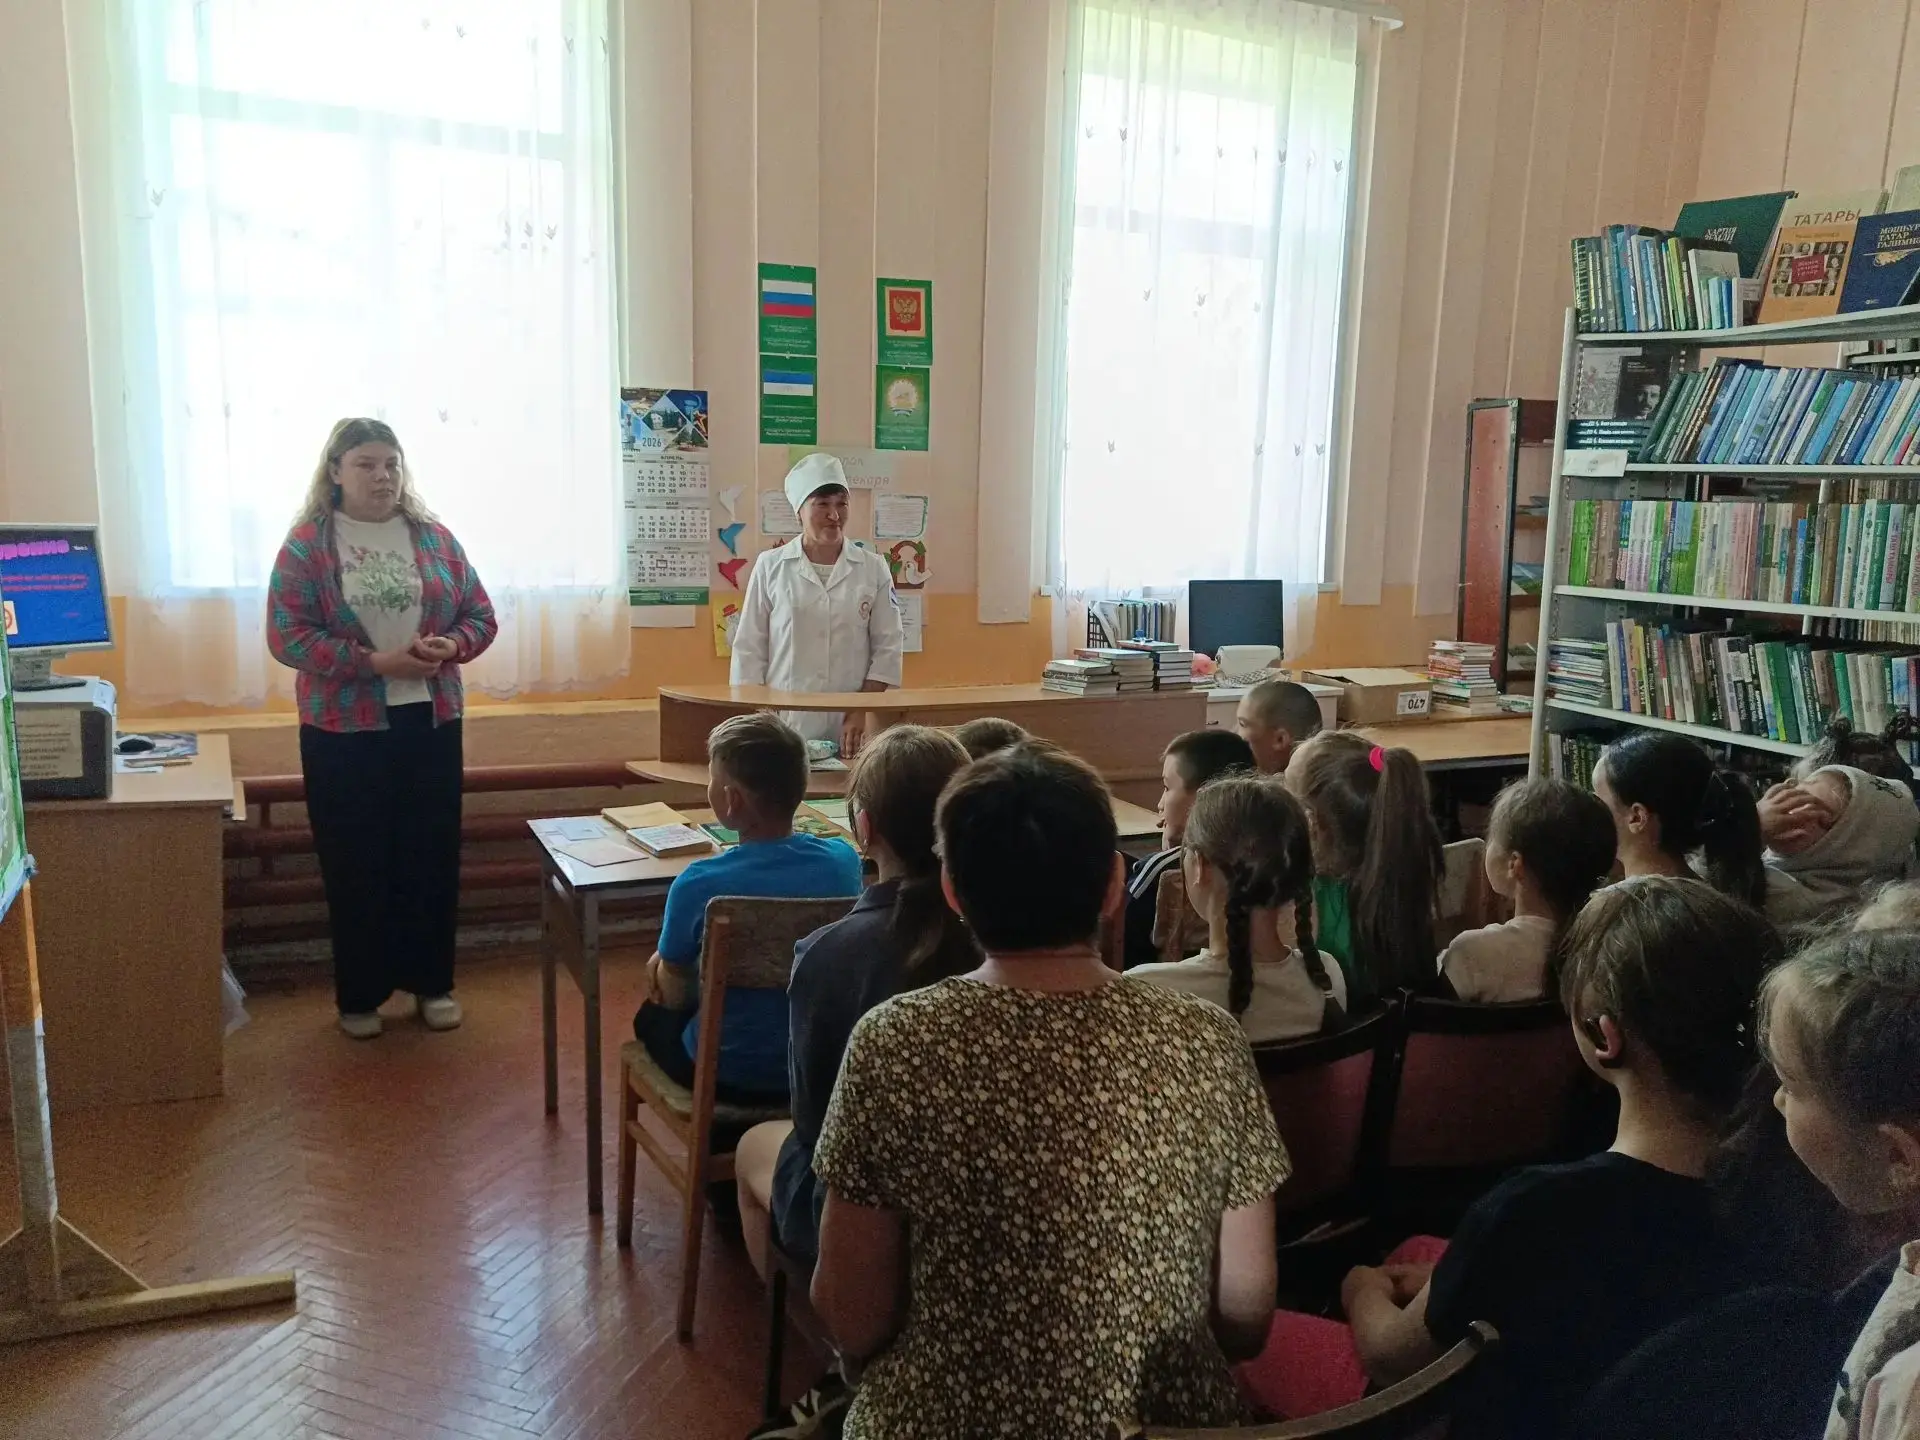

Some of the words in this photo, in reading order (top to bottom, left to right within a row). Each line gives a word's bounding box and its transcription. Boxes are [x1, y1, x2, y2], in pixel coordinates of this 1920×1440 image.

[1794, 209, 1861, 226] ТАТАРЫ
[642, 438, 662, 447] 2026
[1408, 698, 1425, 709] 470
